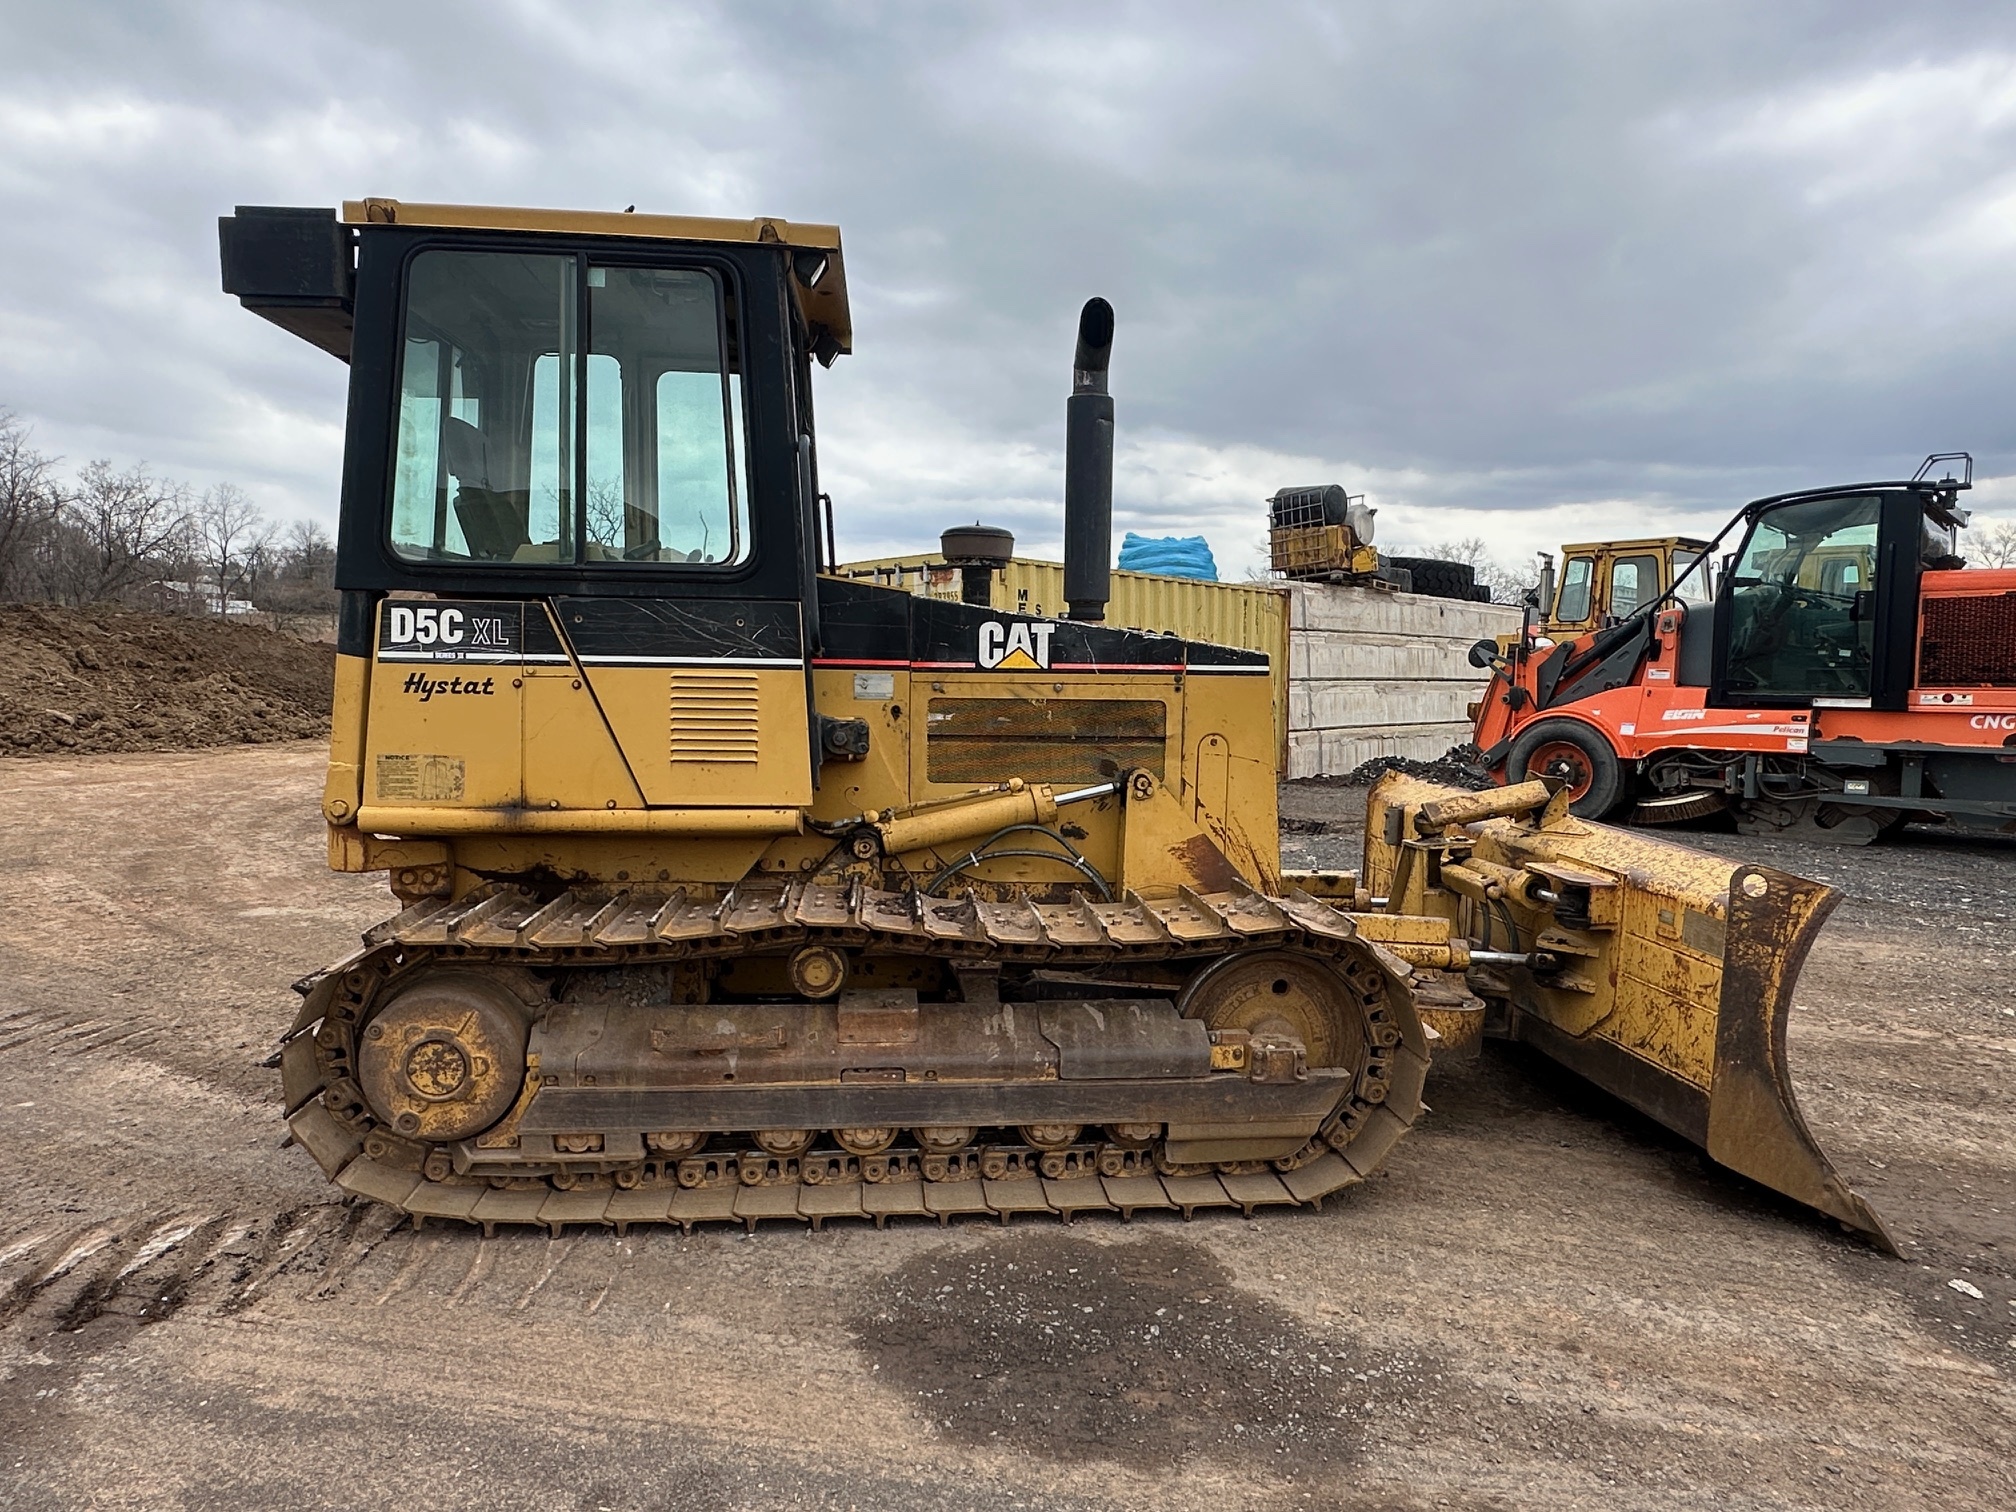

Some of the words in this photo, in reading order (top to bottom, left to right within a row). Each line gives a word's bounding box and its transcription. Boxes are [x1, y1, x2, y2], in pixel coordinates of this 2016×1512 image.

[390, 607, 464, 644] D5C
[471, 618, 509, 645] XL
[978, 621, 1055, 669] CAT
[403, 672, 495, 702] Hystat
[1773, 725, 1805, 734] Pelican
[1970, 715, 2016, 730] CNG
